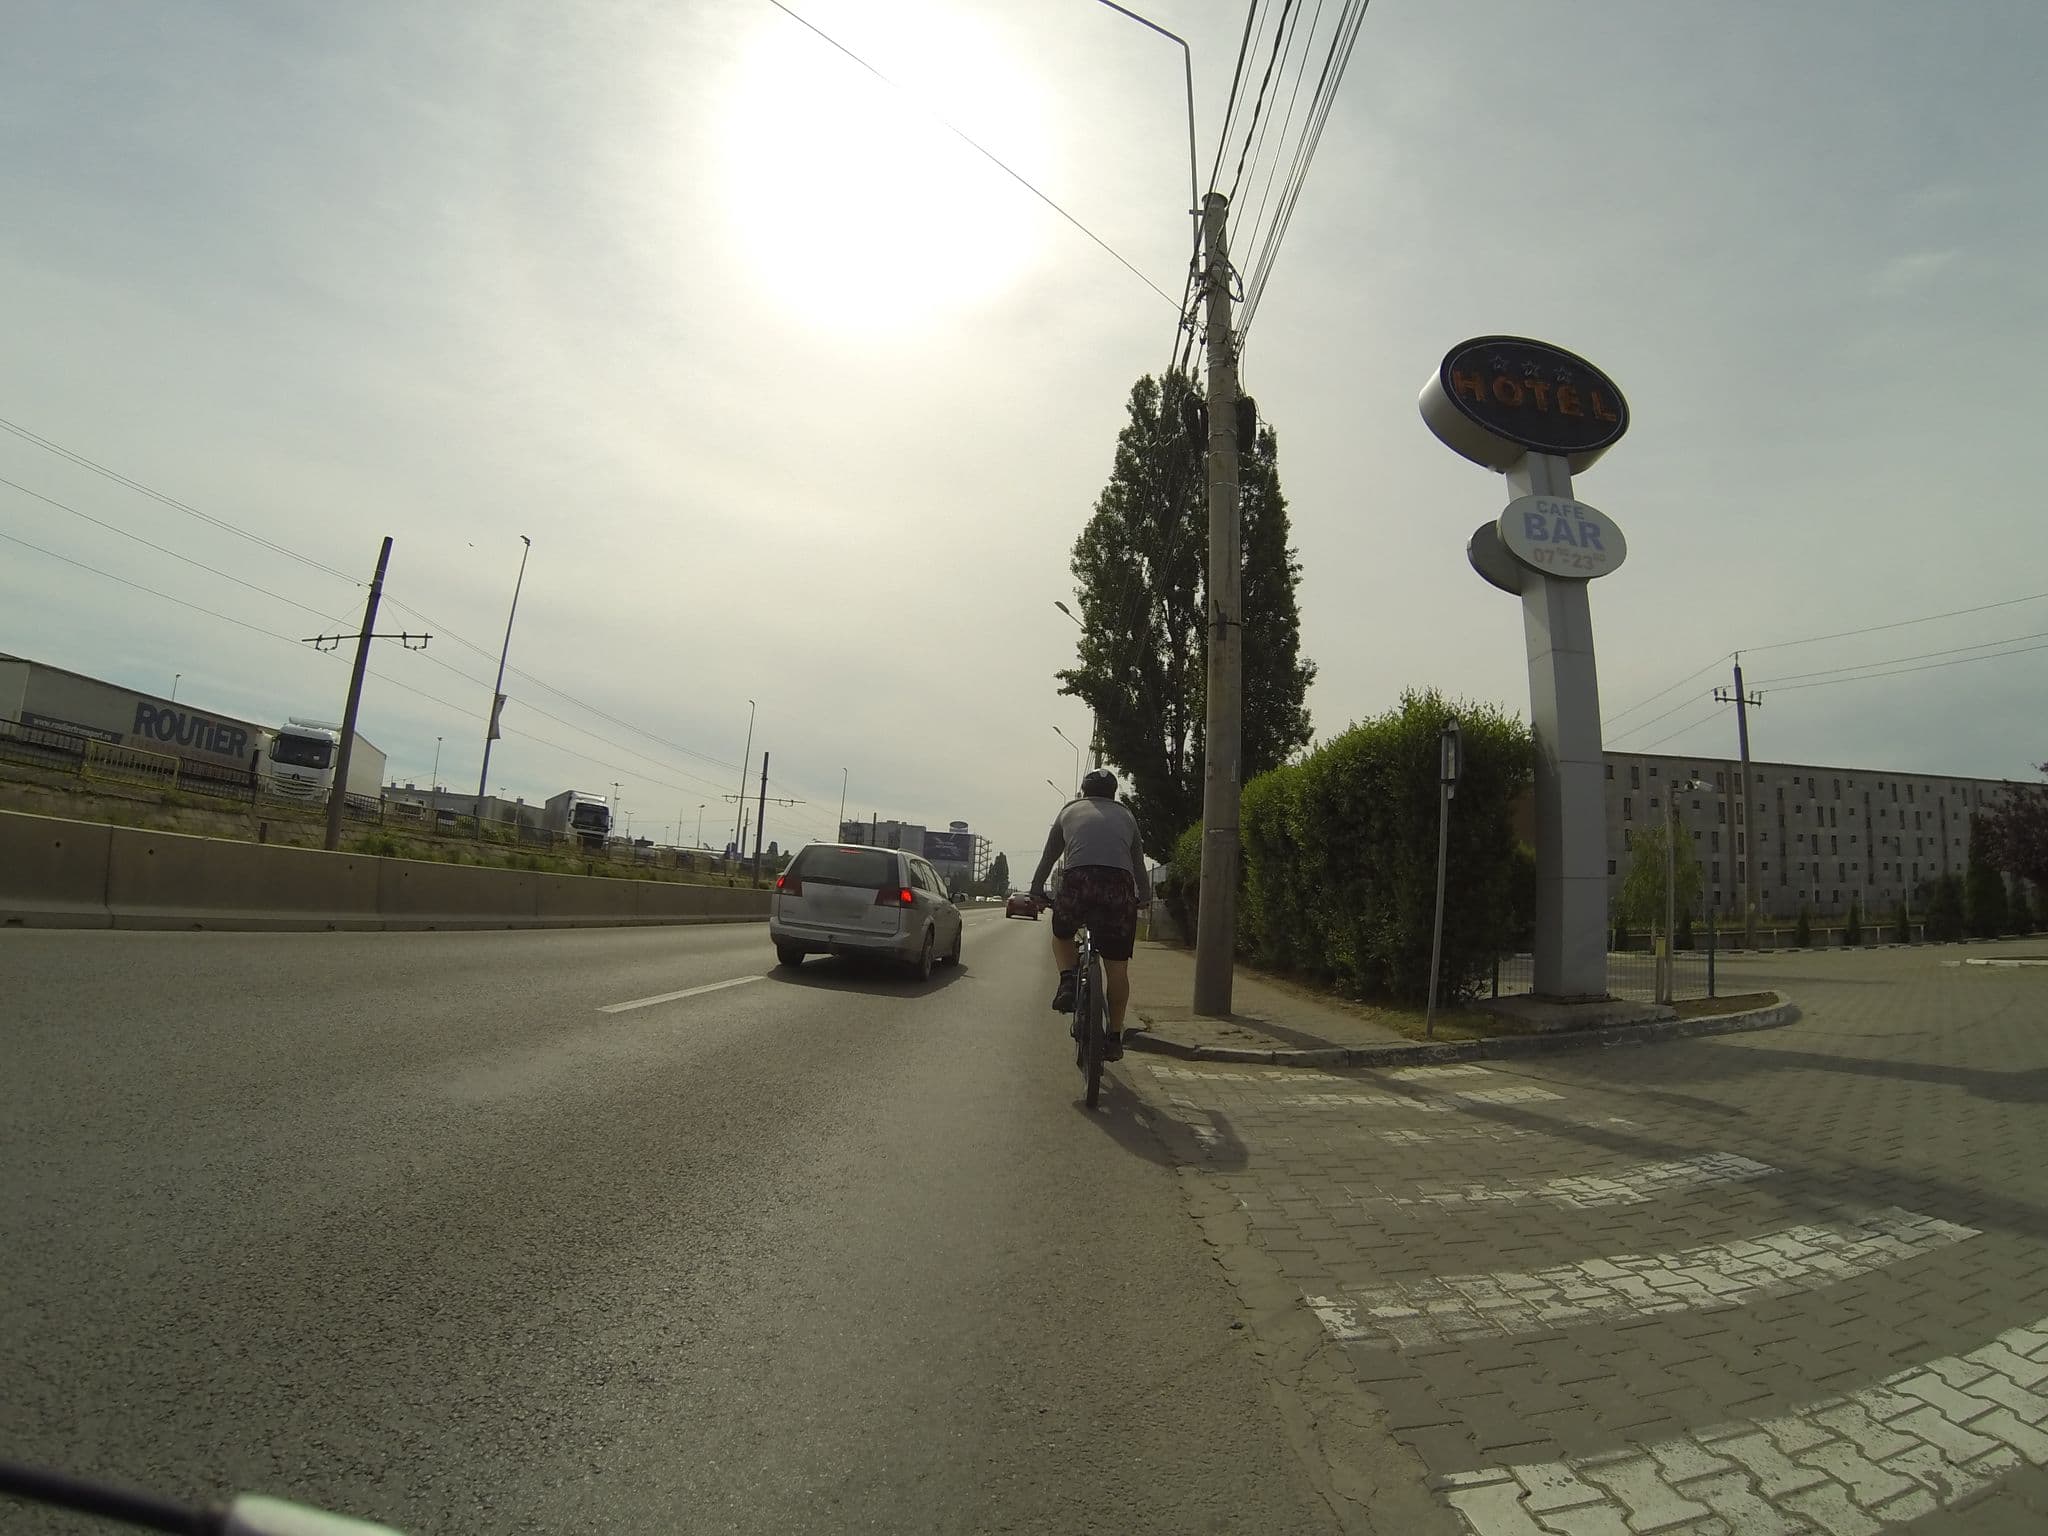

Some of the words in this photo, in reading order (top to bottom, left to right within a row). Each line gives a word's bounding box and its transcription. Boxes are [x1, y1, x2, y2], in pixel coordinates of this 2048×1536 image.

[1453, 369, 1617, 422] HOTEL
[1536, 501, 1584, 520] CAFE
[1523, 512, 1604, 550] BAR
